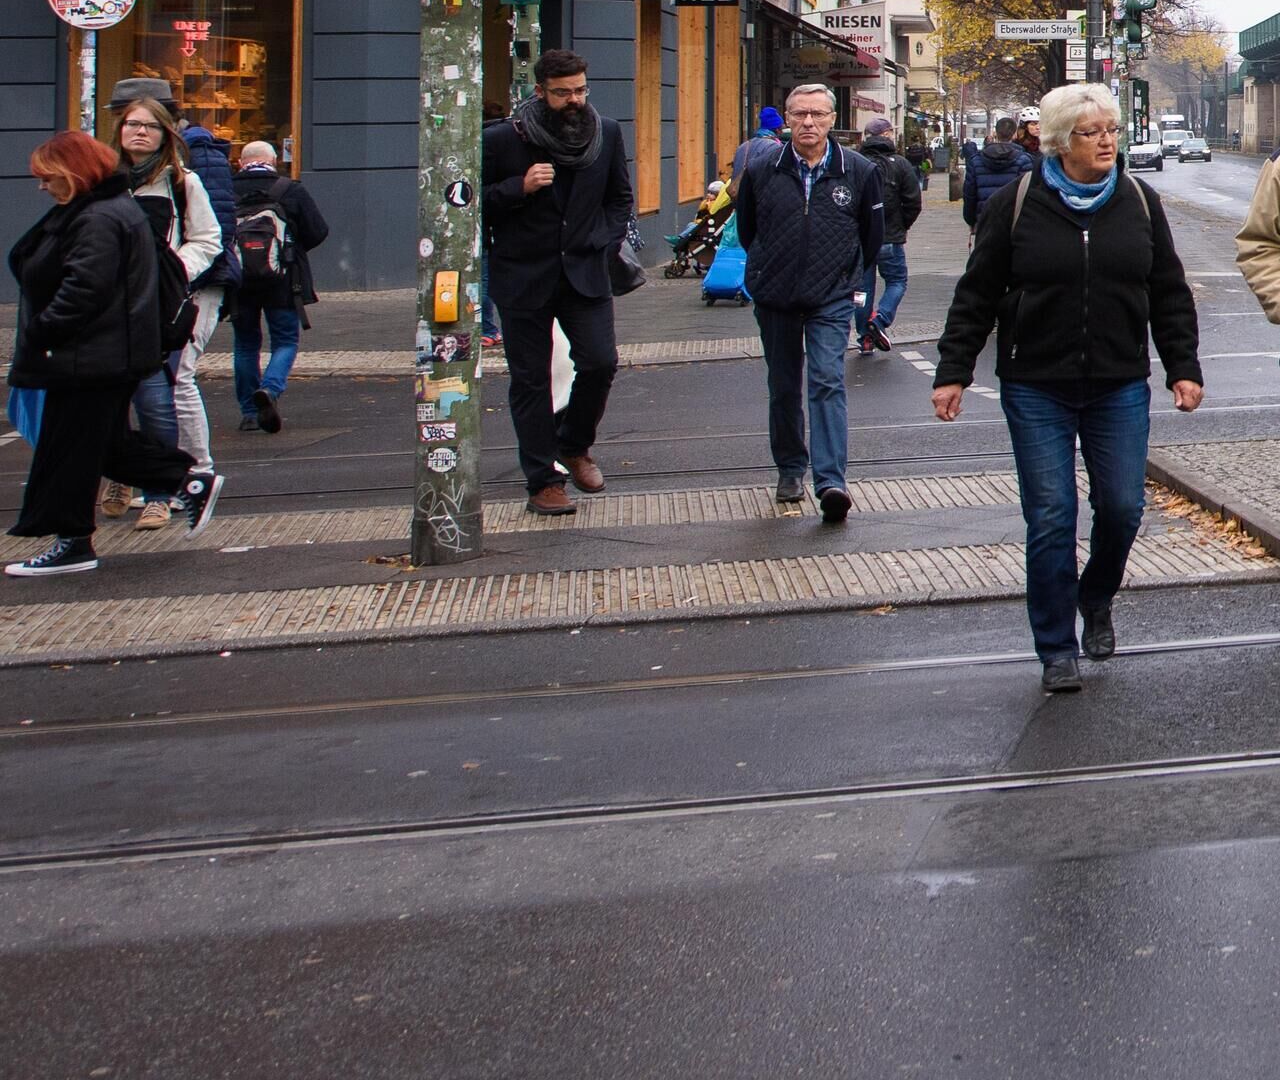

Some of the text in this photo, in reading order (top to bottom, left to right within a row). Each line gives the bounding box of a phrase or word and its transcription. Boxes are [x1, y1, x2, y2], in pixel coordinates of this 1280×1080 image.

[824, 15, 882, 28] RIESEN
[1000, 24, 1077, 36] Eberswalder Straße
